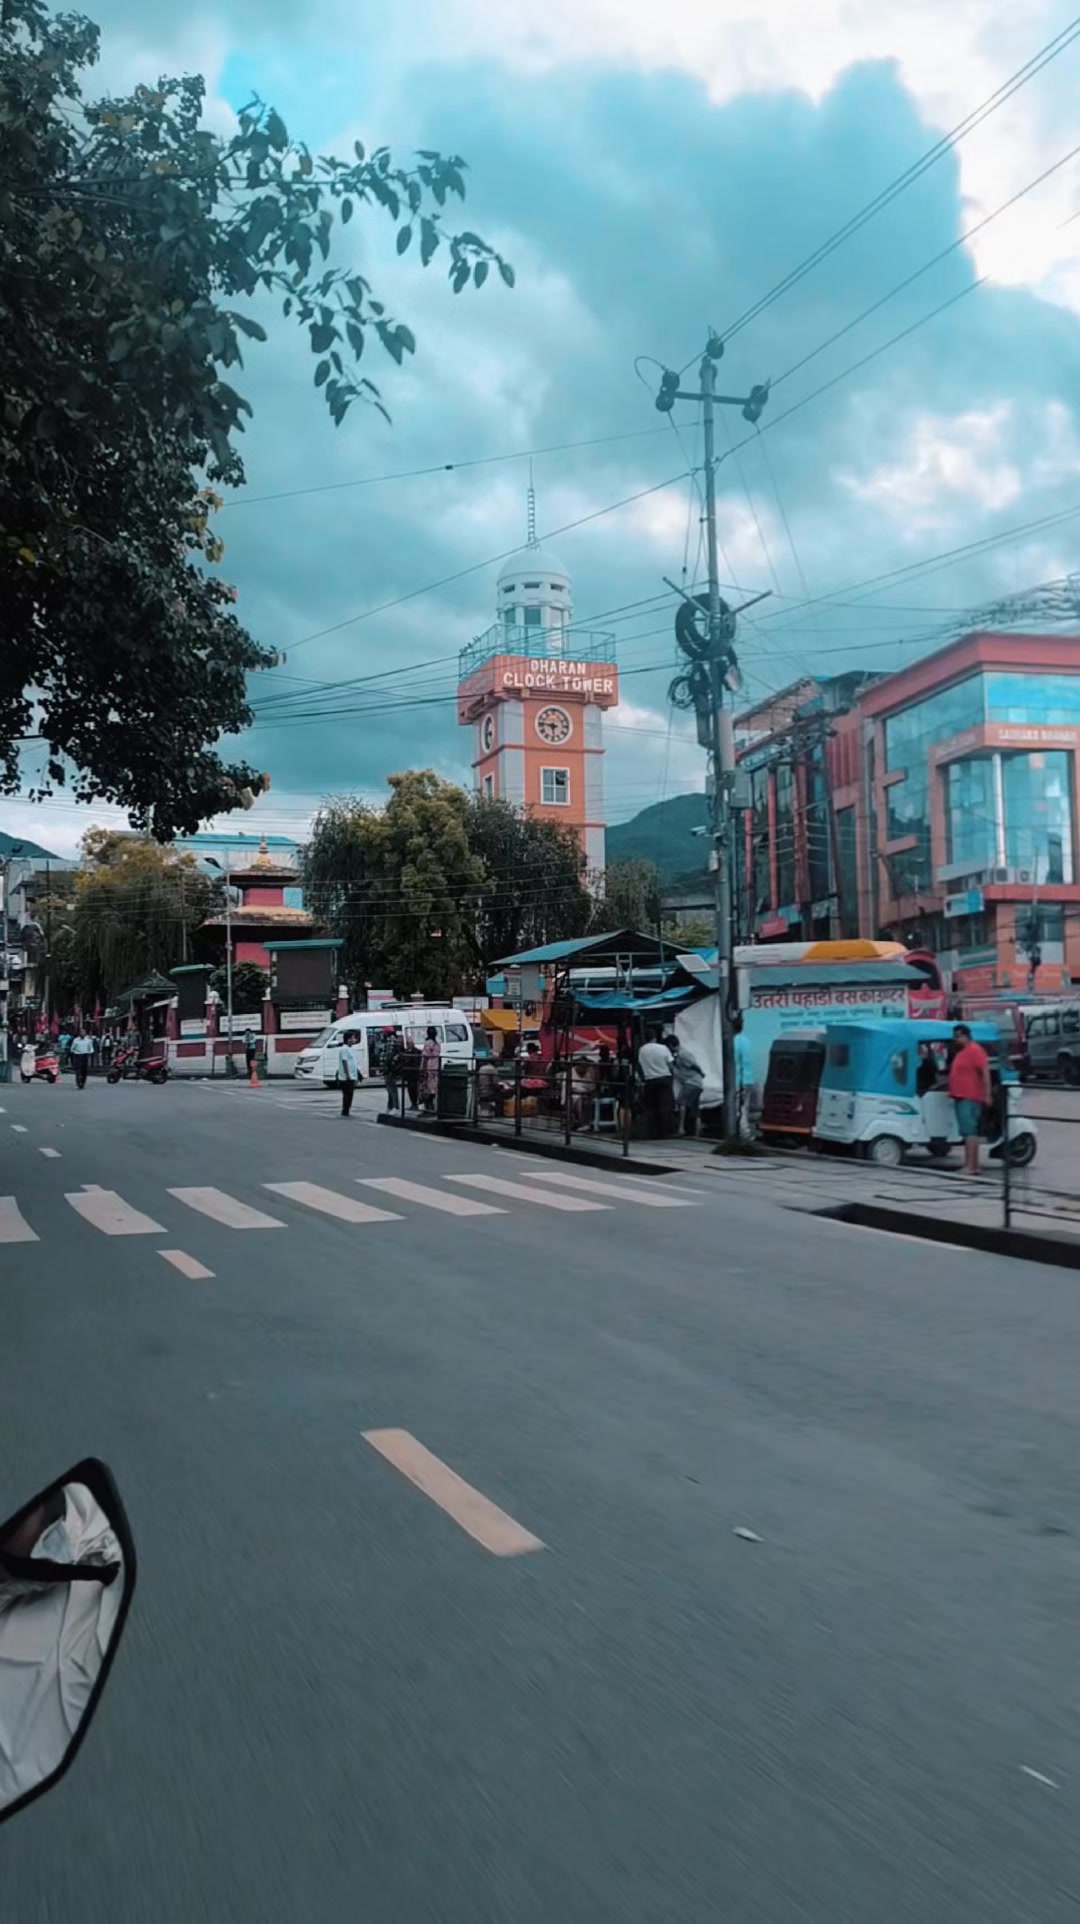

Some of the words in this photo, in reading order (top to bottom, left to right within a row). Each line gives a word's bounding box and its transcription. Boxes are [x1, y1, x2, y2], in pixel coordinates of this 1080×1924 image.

[530, 660, 586, 674] DHARAN
[503, 671, 556, 689] CLOCK
[561, 675, 613, 693] TOWER
